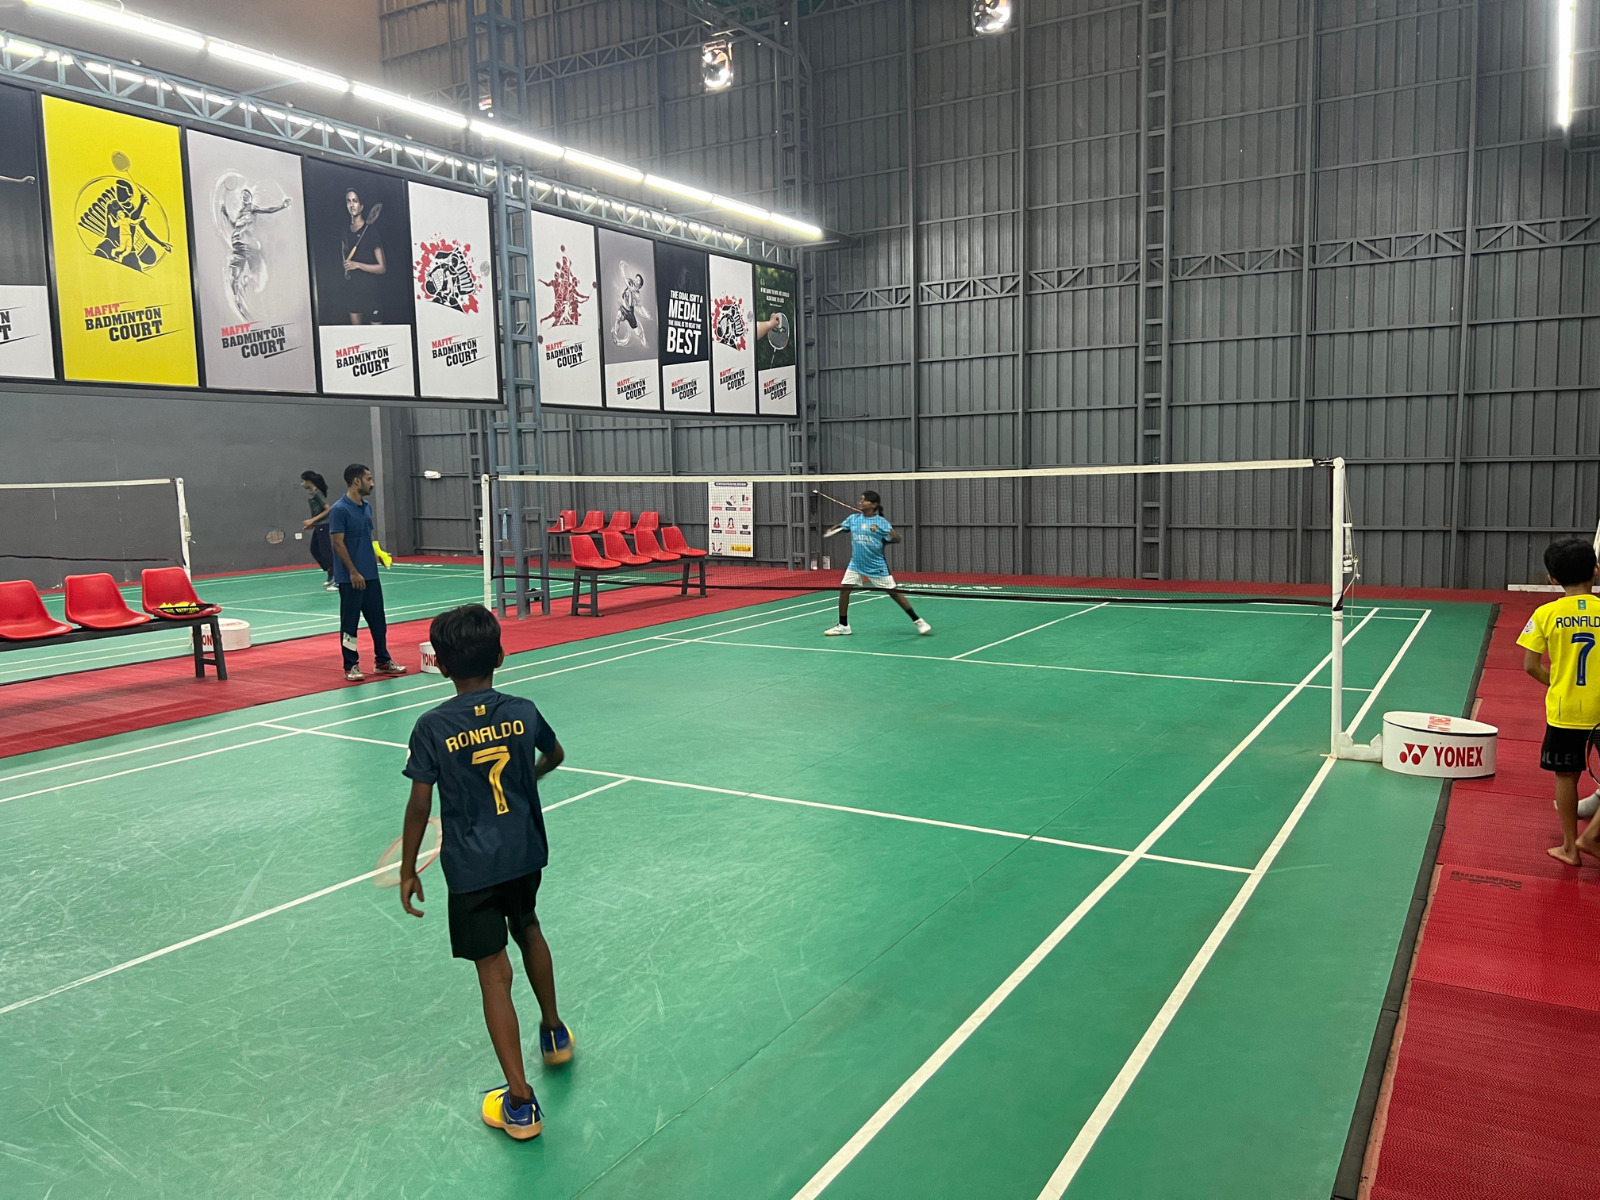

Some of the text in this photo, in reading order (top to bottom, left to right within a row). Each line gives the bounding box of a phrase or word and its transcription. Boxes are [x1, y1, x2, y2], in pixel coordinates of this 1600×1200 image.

[84, 303, 120, 317] MAFIT
[85, 308, 161, 330] BADMINTON
[668, 299, 702, 322] MEDAL
[109, 320, 162, 341] COURT
[221, 322, 250, 337] MAFIT
[222, 327, 285, 348] BADMINTON
[241, 338, 286, 358] COURT
[431, 336, 453, 348] MAFIT
[432, 339, 477, 358] BADMINTON
[546, 341, 563, 351] MAFIT
[666, 326, 702, 355] BEST
[336, 345, 360, 357] MAFIT
[336, 348, 388, 368] BADMINTON
[446, 351, 478, 367] COURT
[546, 344, 582, 360] BADMINTON
[557, 353, 583, 367] COURT
[353, 357, 389, 377] COURT
[617, 379, 645, 394] BADMINTON
[626, 387, 646, 400] COURT
[1556, 616, 1600, 628] RONALD
[1571, 632, 1596, 686] 7
[445, 720, 525, 752] RONALDO
[1433, 746, 1483, 767] YONEX
[471, 745, 511, 815] 7
